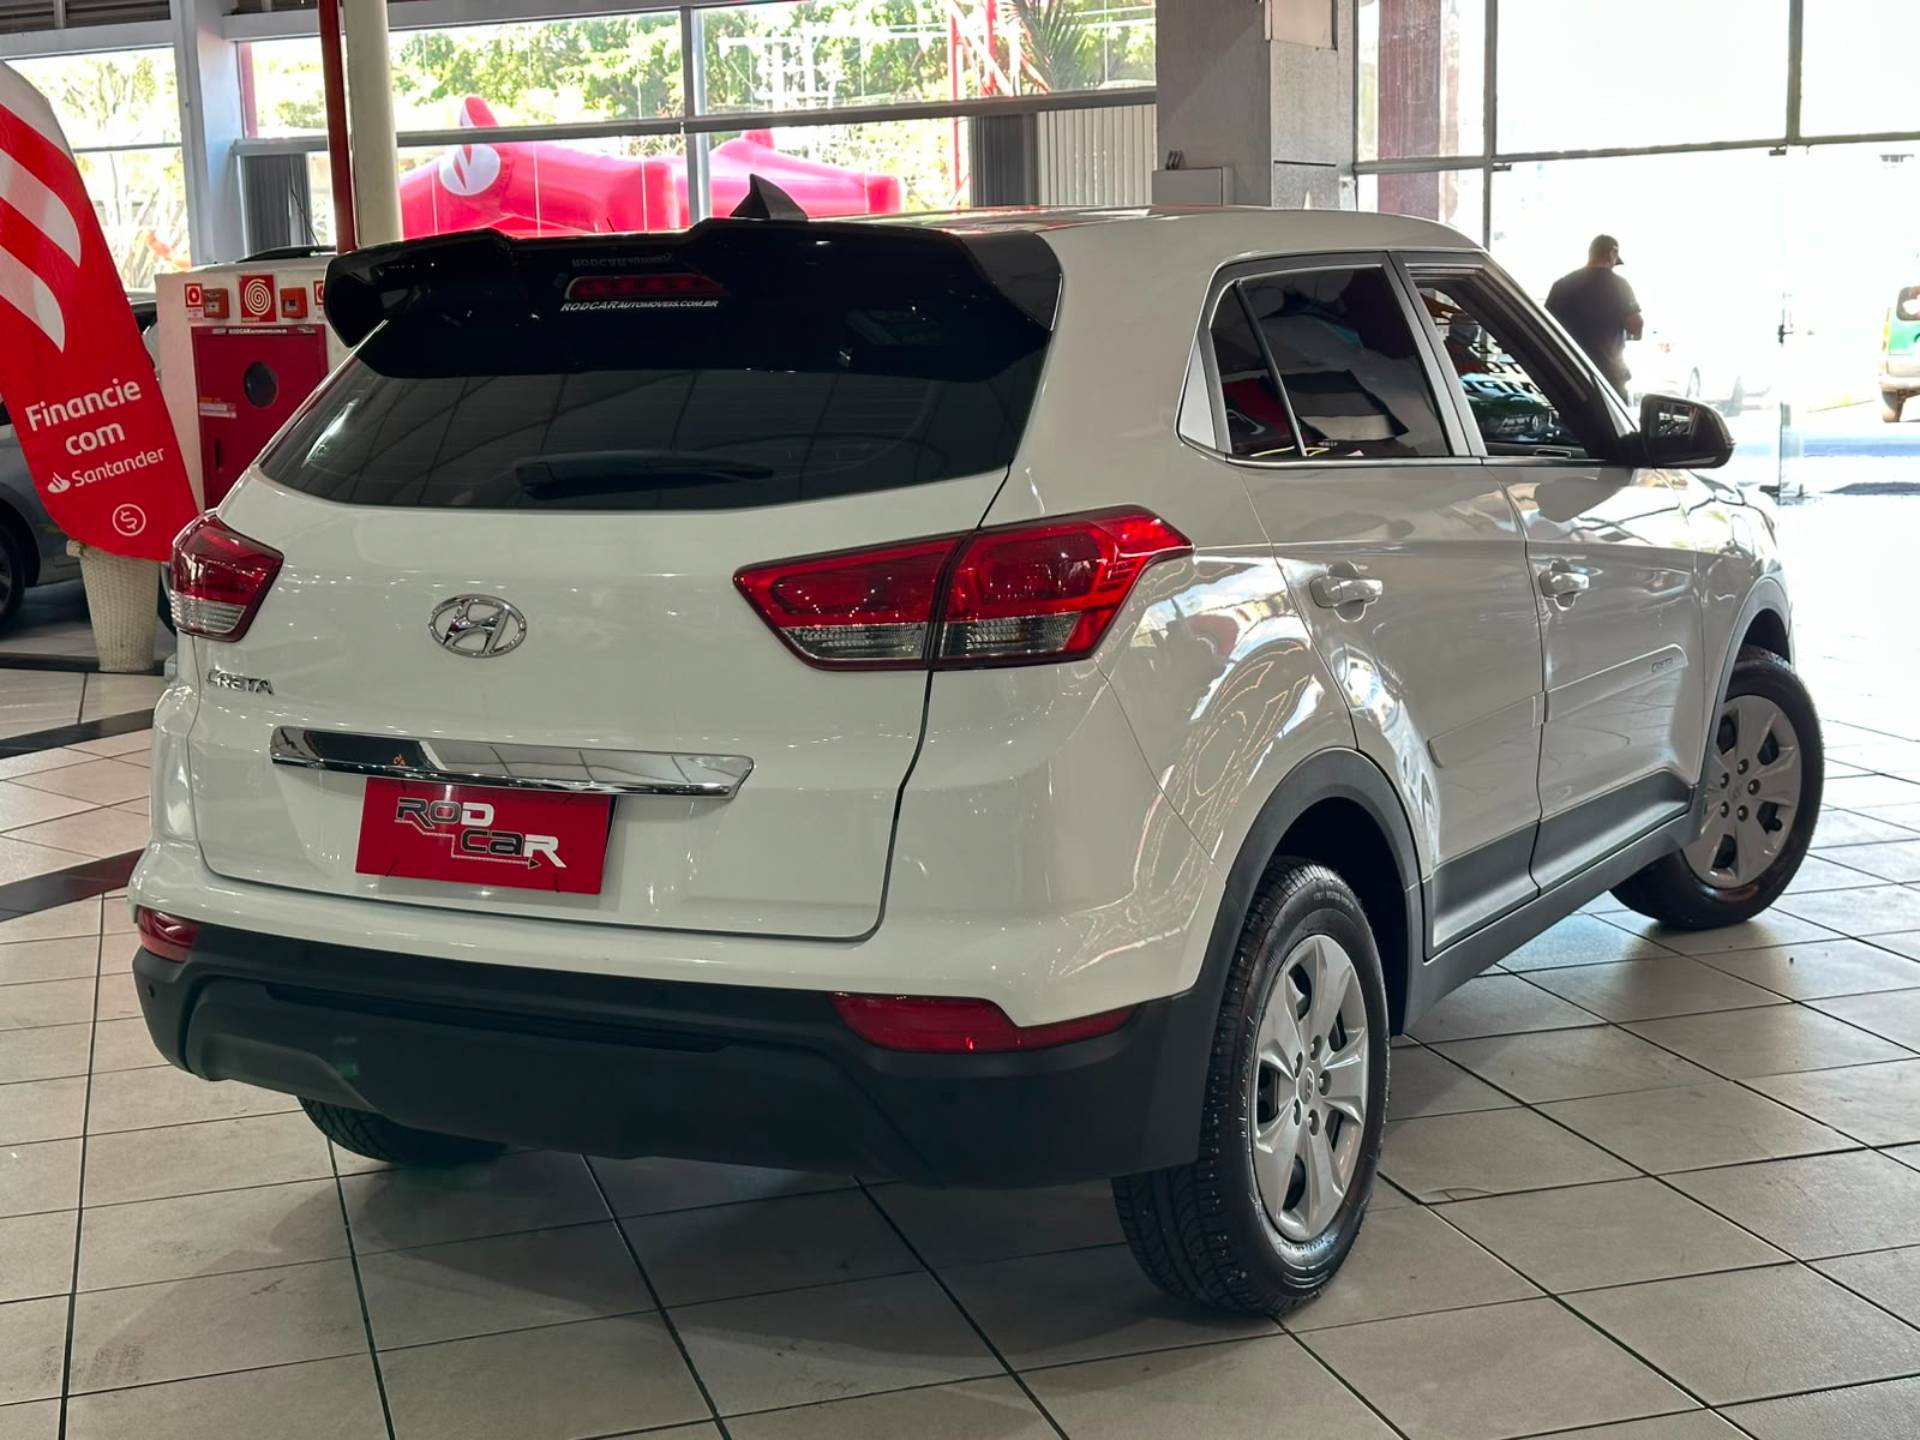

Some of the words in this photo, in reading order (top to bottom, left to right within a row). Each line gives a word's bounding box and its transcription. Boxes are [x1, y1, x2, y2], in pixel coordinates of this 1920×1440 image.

[25, 378, 142, 432] Financie
[65, 422, 126, 456] com
[72, 448, 165, 487] Santander
[207, 668, 275, 696] CRETA
[395, 797, 495, 829] ROD
